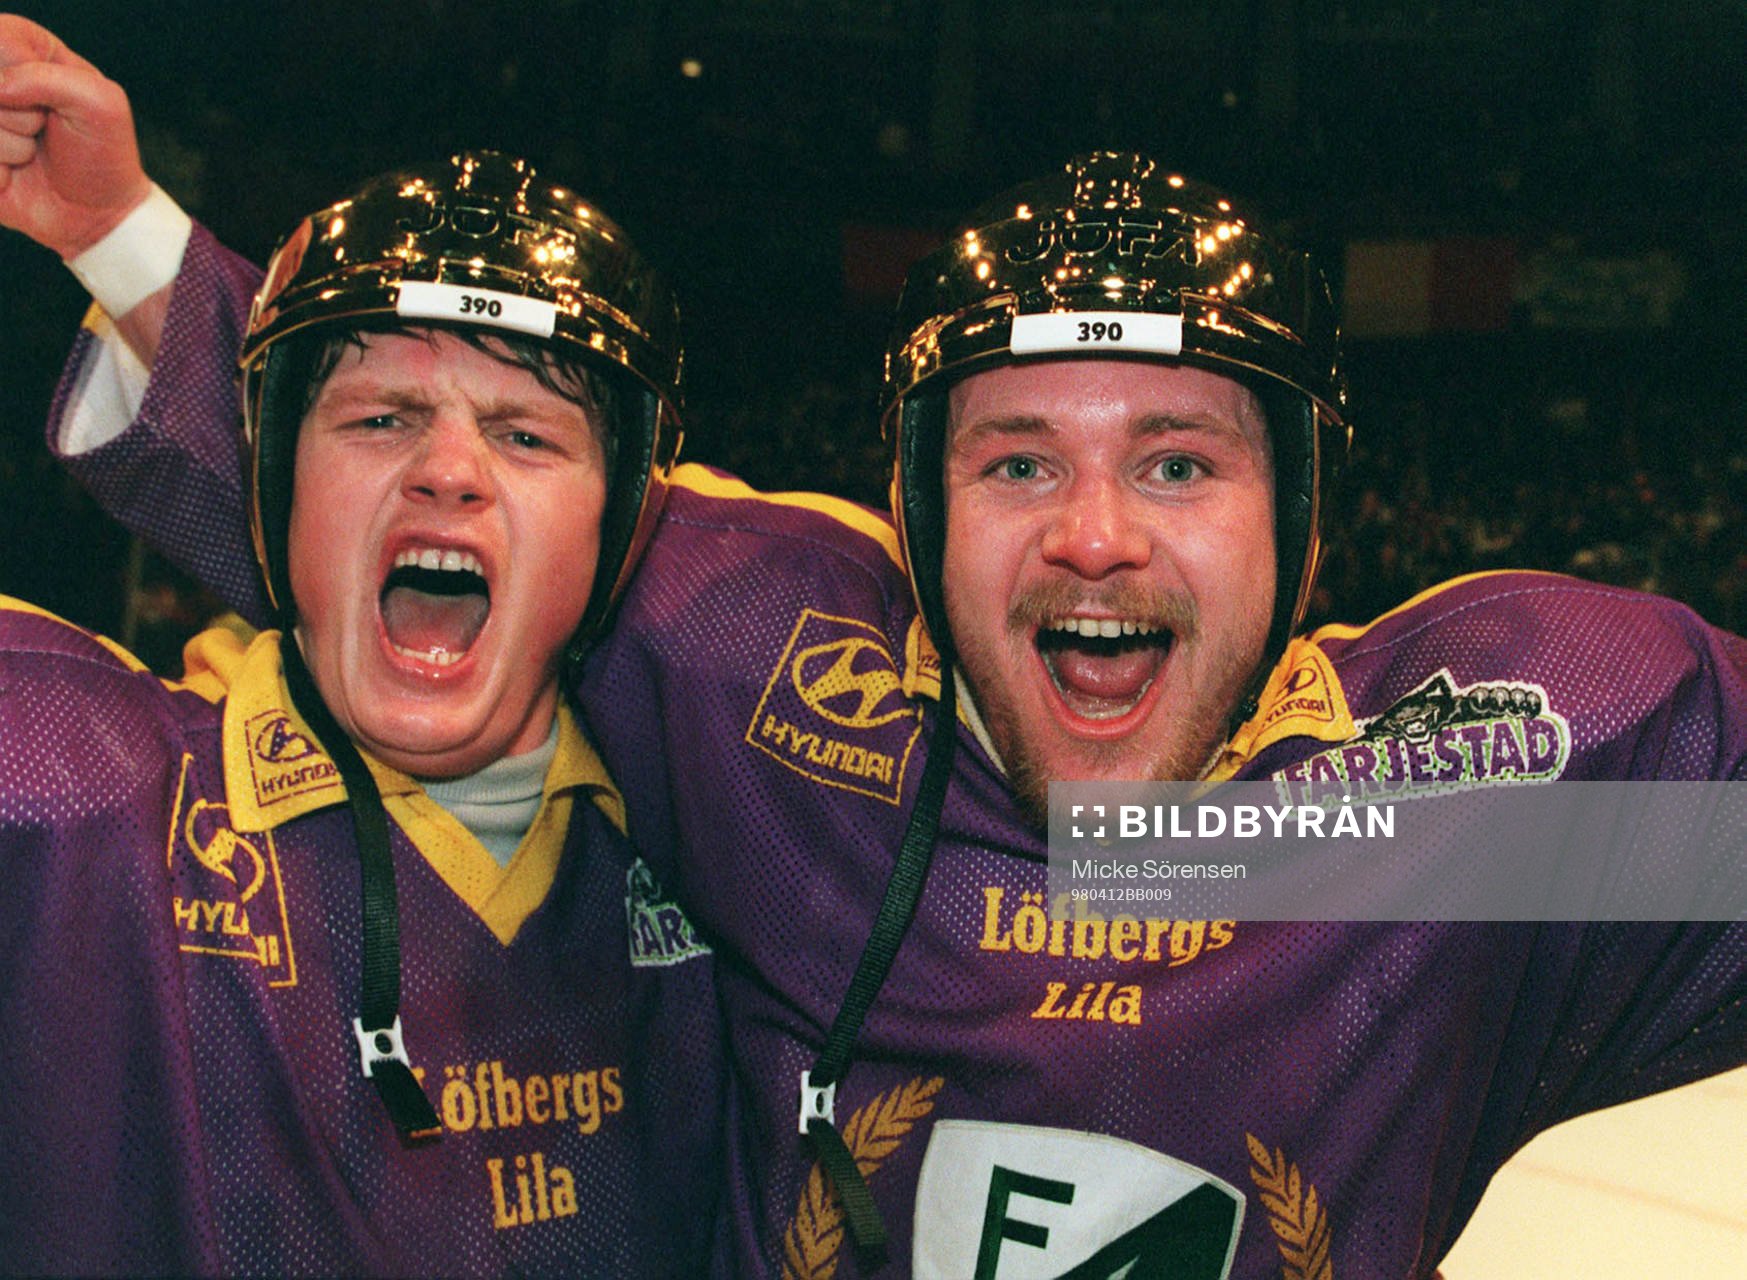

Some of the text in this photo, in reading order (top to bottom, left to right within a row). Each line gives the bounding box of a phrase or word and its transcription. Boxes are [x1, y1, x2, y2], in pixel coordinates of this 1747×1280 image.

[1005, 217, 1202, 267] JOFA
[459, 295, 502, 317] 390
[1077, 322, 1123, 341] 390
[762, 714, 894, 784] HYUNDAI
[980, 887, 1236, 967] Löfbergs
[1031, 982, 1143, 1025] Lila
[411, 1060, 624, 1135] öfbergs
[487, 1152, 579, 1229] Lila
[974, 1165, 1076, 1280] F
